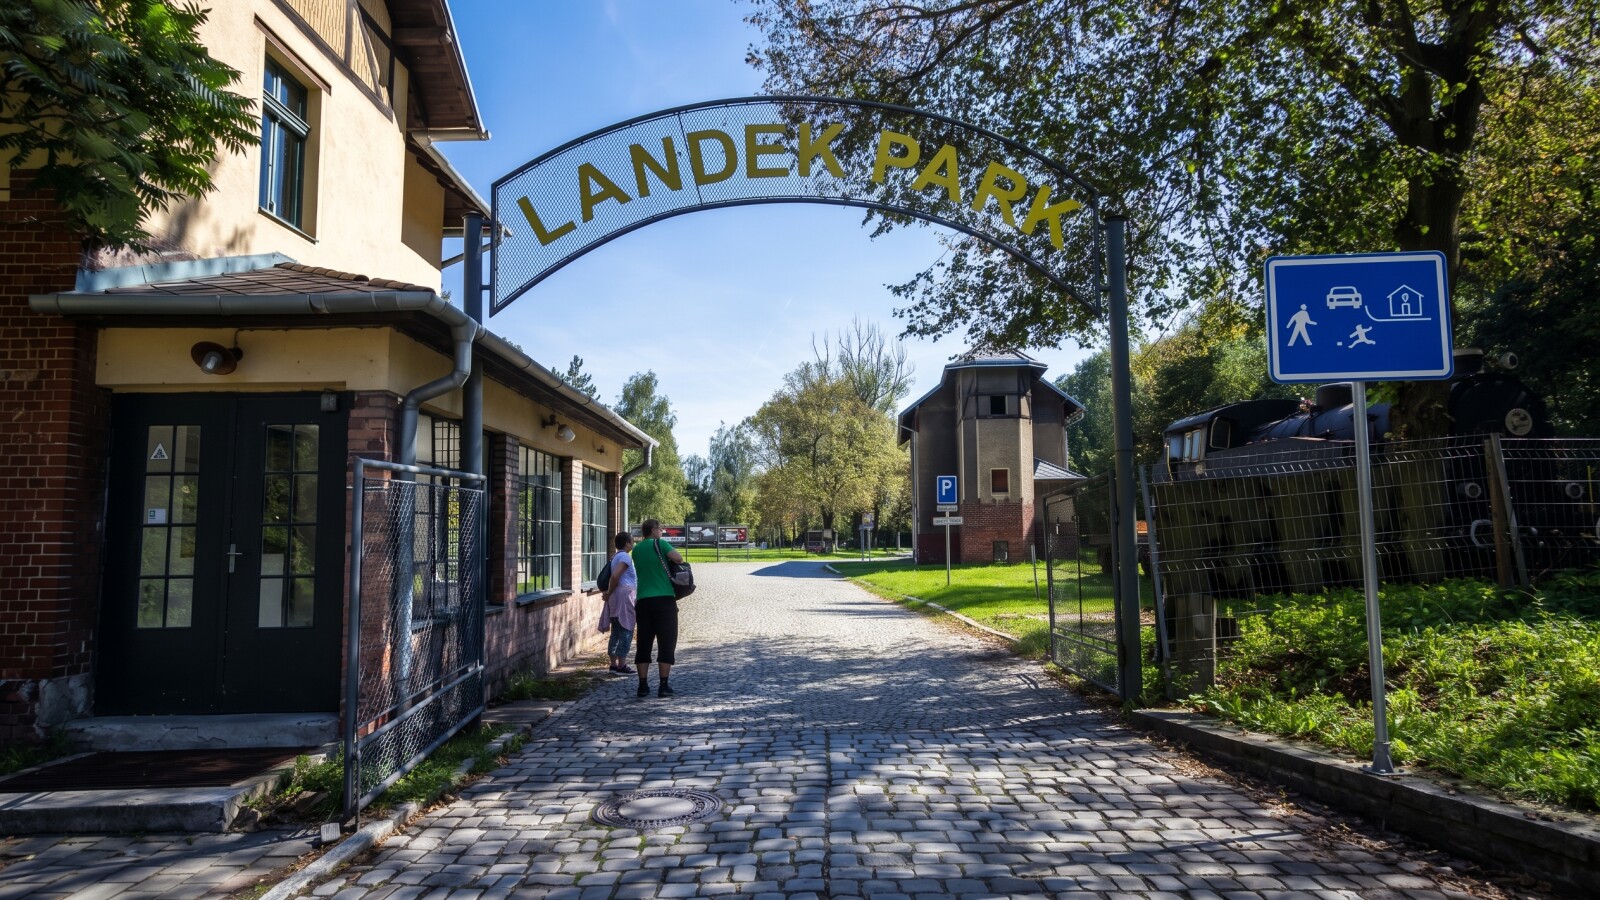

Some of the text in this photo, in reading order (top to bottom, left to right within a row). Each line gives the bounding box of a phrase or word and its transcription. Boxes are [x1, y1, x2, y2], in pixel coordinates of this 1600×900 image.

[517, 123, 1082, 251] LANDEK PARK
[942, 479, 952, 496] P
